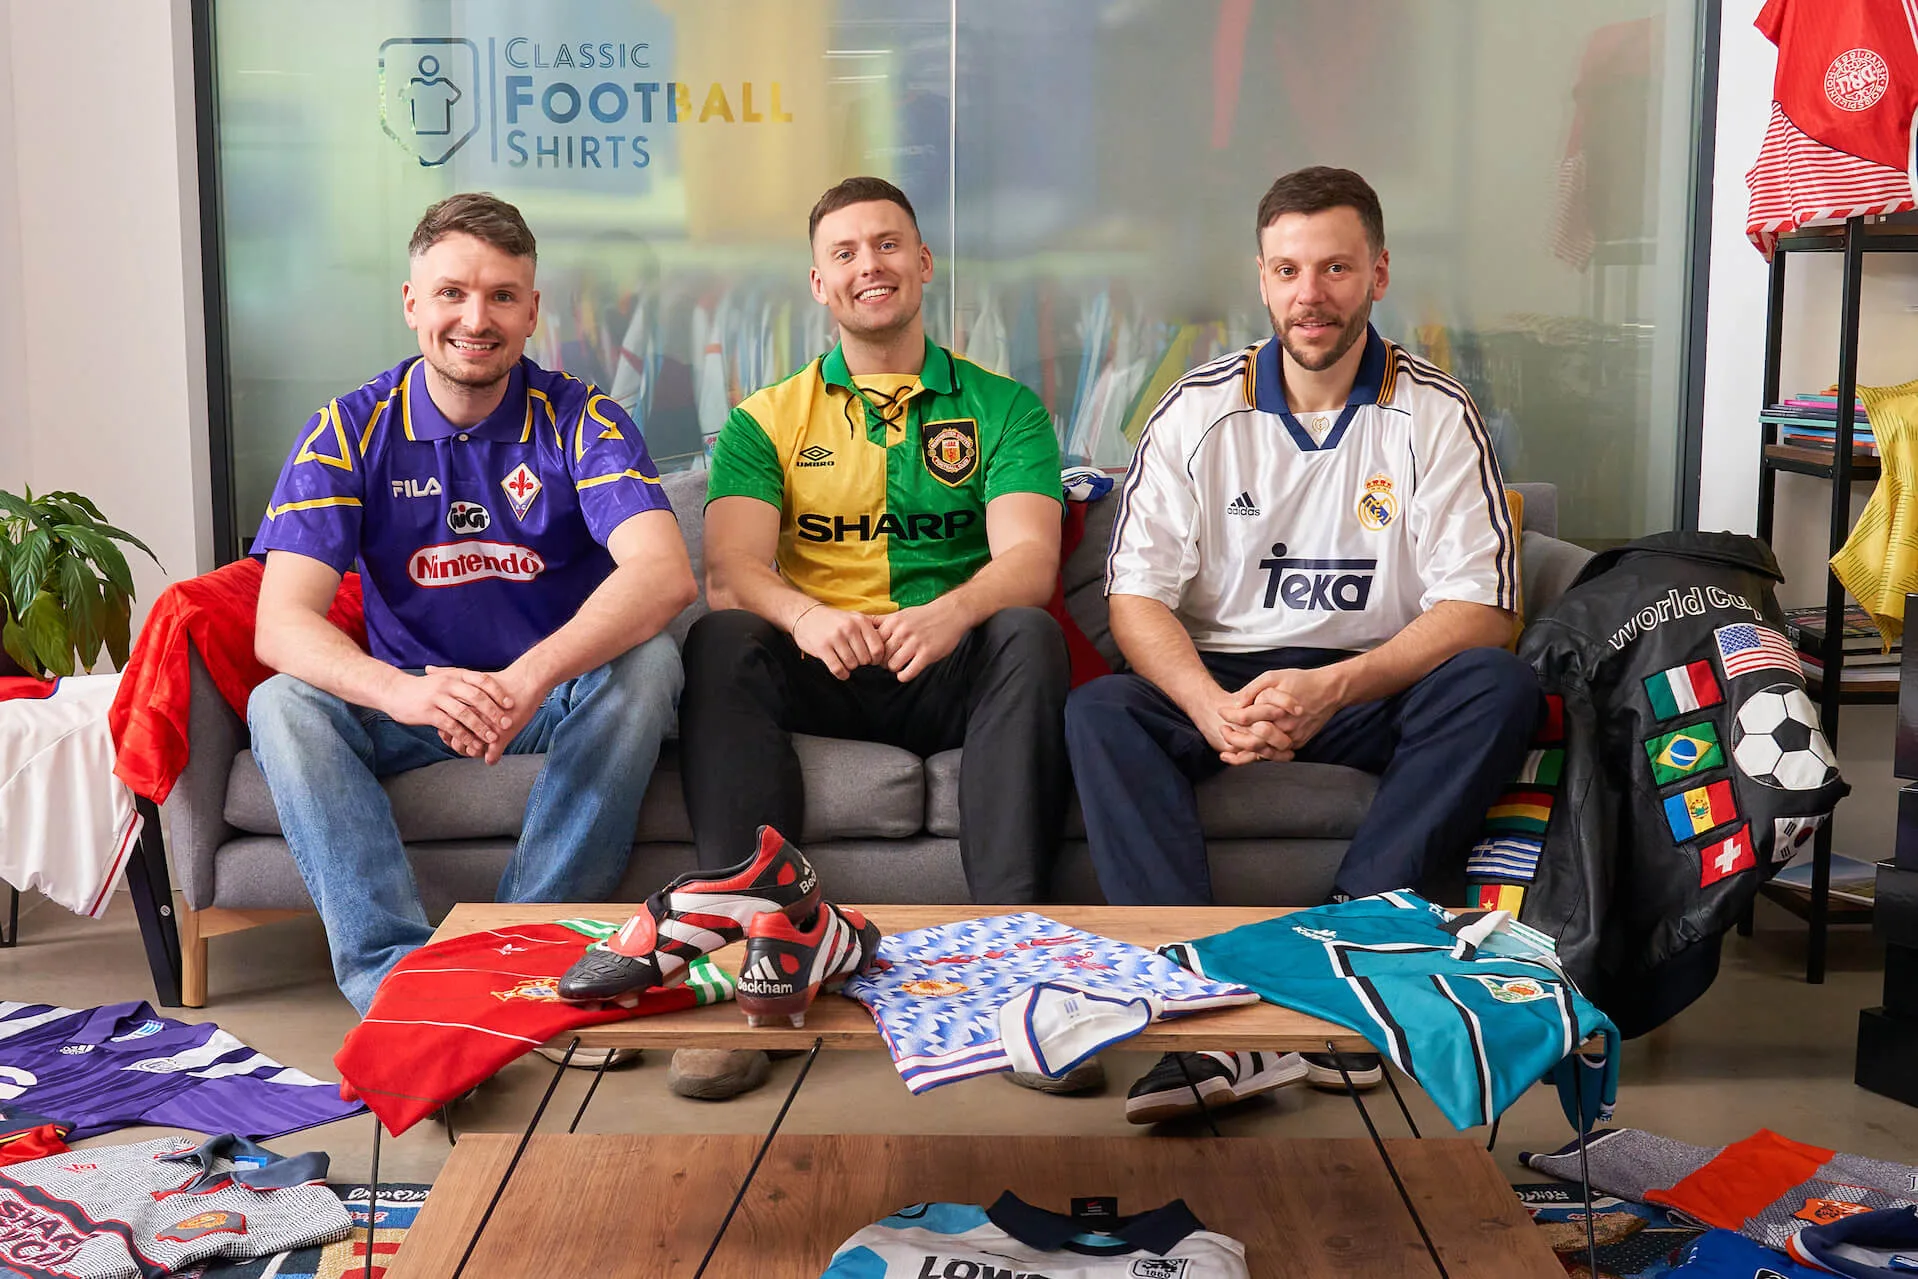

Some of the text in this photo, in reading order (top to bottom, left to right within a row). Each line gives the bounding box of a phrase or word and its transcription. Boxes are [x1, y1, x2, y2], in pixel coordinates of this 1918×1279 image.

[505, 36, 651, 69] CLASSIC
[505, 75, 793, 124] FOOTBALL
[507, 131, 651, 168] SHIRTS
[391, 477, 442, 498] FILA
[797, 509, 976, 542] SHARP
[1227, 507, 1260, 516] adidas
[737, 976, 793, 994] Beckham
